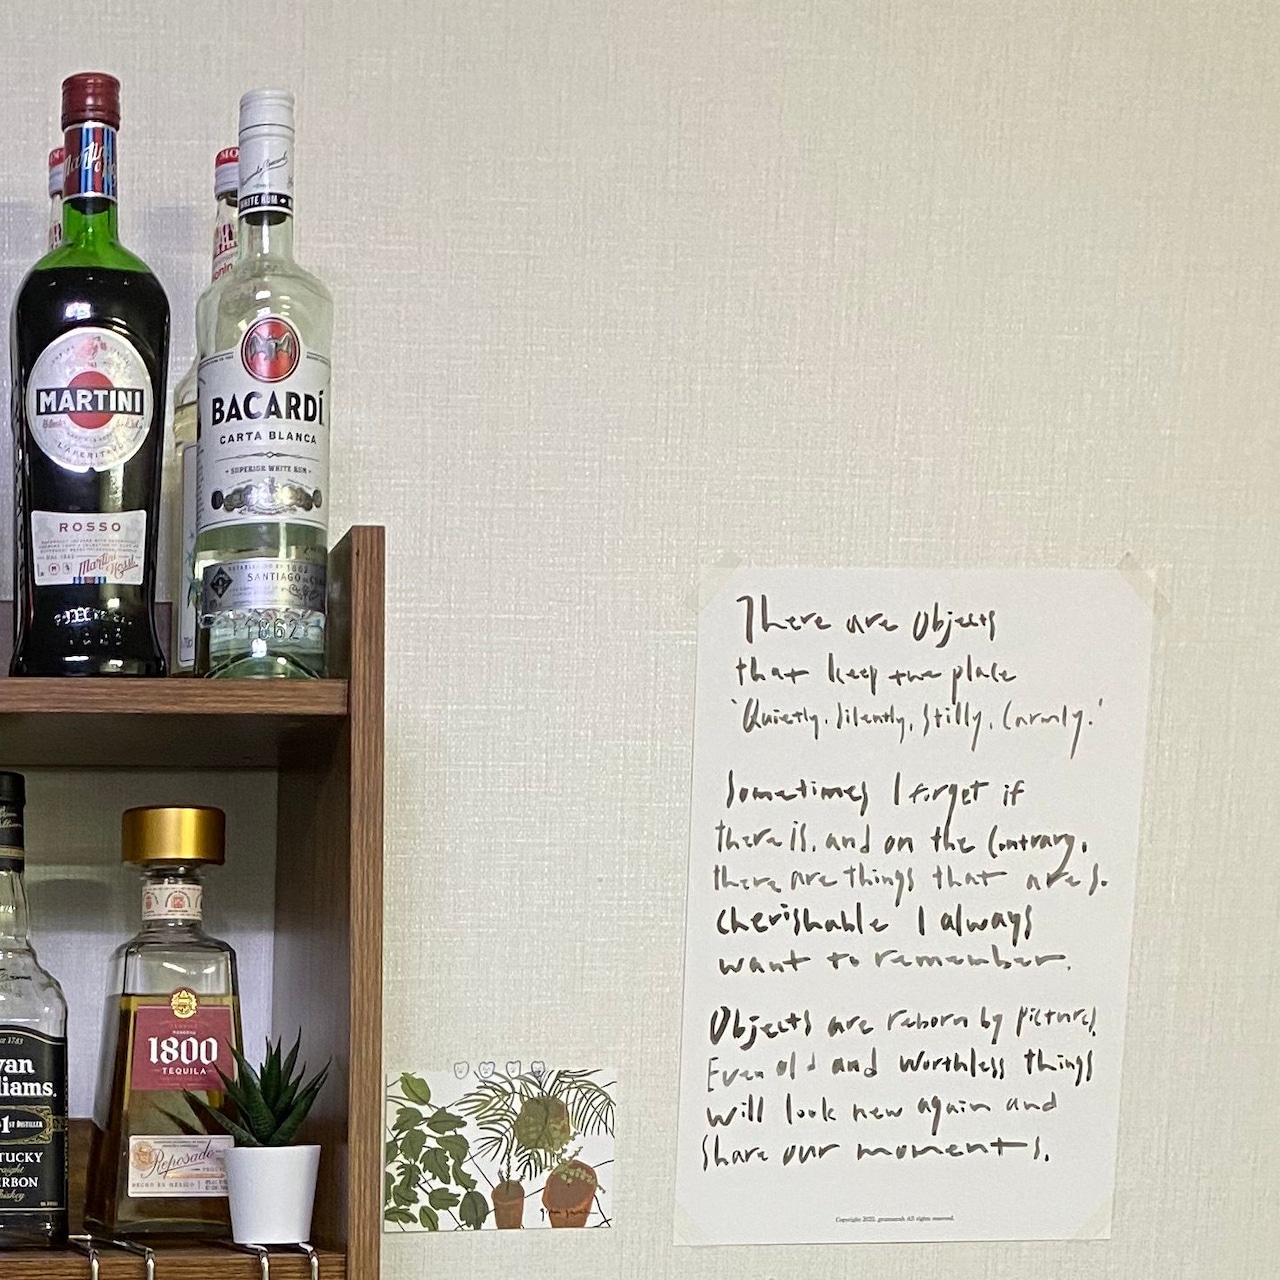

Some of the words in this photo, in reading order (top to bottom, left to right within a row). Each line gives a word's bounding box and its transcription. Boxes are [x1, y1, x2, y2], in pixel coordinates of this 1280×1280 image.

[40, 389, 141, 413] MARTINI
[211, 390, 325, 427] BACARDÍ
[219, 431, 262, 445] CARTA
[269, 431, 317, 445] BLANCA
[230, 465, 267, 475] SUPERIOR
[268, 465, 292, 473] WHITE
[59, 522, 121, 533] ROSSO
[247, 573, 301, 583] SANTIAGO
[735, 594, 832, 644] There
[846, 609, 899, 634] are
[735, 656, 810, 683] that
[827, 652, 878, 695] keep
[952, 654, 1017, 704] place
[894, 771, 902, 807] I
[908, 779, 990, 828] forget
[1003, 779, 1025, 807] if
[715, 819, 783, 853] there
[824, 823, 871, 855] and
[884, 834, 914, 855] on
[930, 818, 976, 855] the
[713, 863, 782, 894] there
[790, 872, 838, 890] are
[844, 863, 915, 907] things
[932, 865, 1008, 891] that
[918, 905, 926, 936] I
[940, 902, 1034, 947] always
[719, 949, 812, 975] want
[826, 950, 861, 969] to
[709, 1004, 813, 1051] Objects
[827, 1013, 875, 1038] are
[887, 1008, 969, 1033] reborn
[980, 1006, 1004, 1046] by
[147, 1036, 218, 1066] 1800
[162, 1067, 207, 1075] TEQUILA
[707, 1056, 765, 1093] Even
[776, 1051, 817, 1080] old
[831, 1047, 878, 1078] and
[1024, 1049, 1094, 1088] things
[785, 1092, 837, 1125] look
[852, 1102, 903, 1122] new
[917, 1094, 992, 1137] again
[1005, 1091, 1058, 1112] and
[140, 1139, 216, 1179] Reposado
[782, 1144, 841, 1167] our
